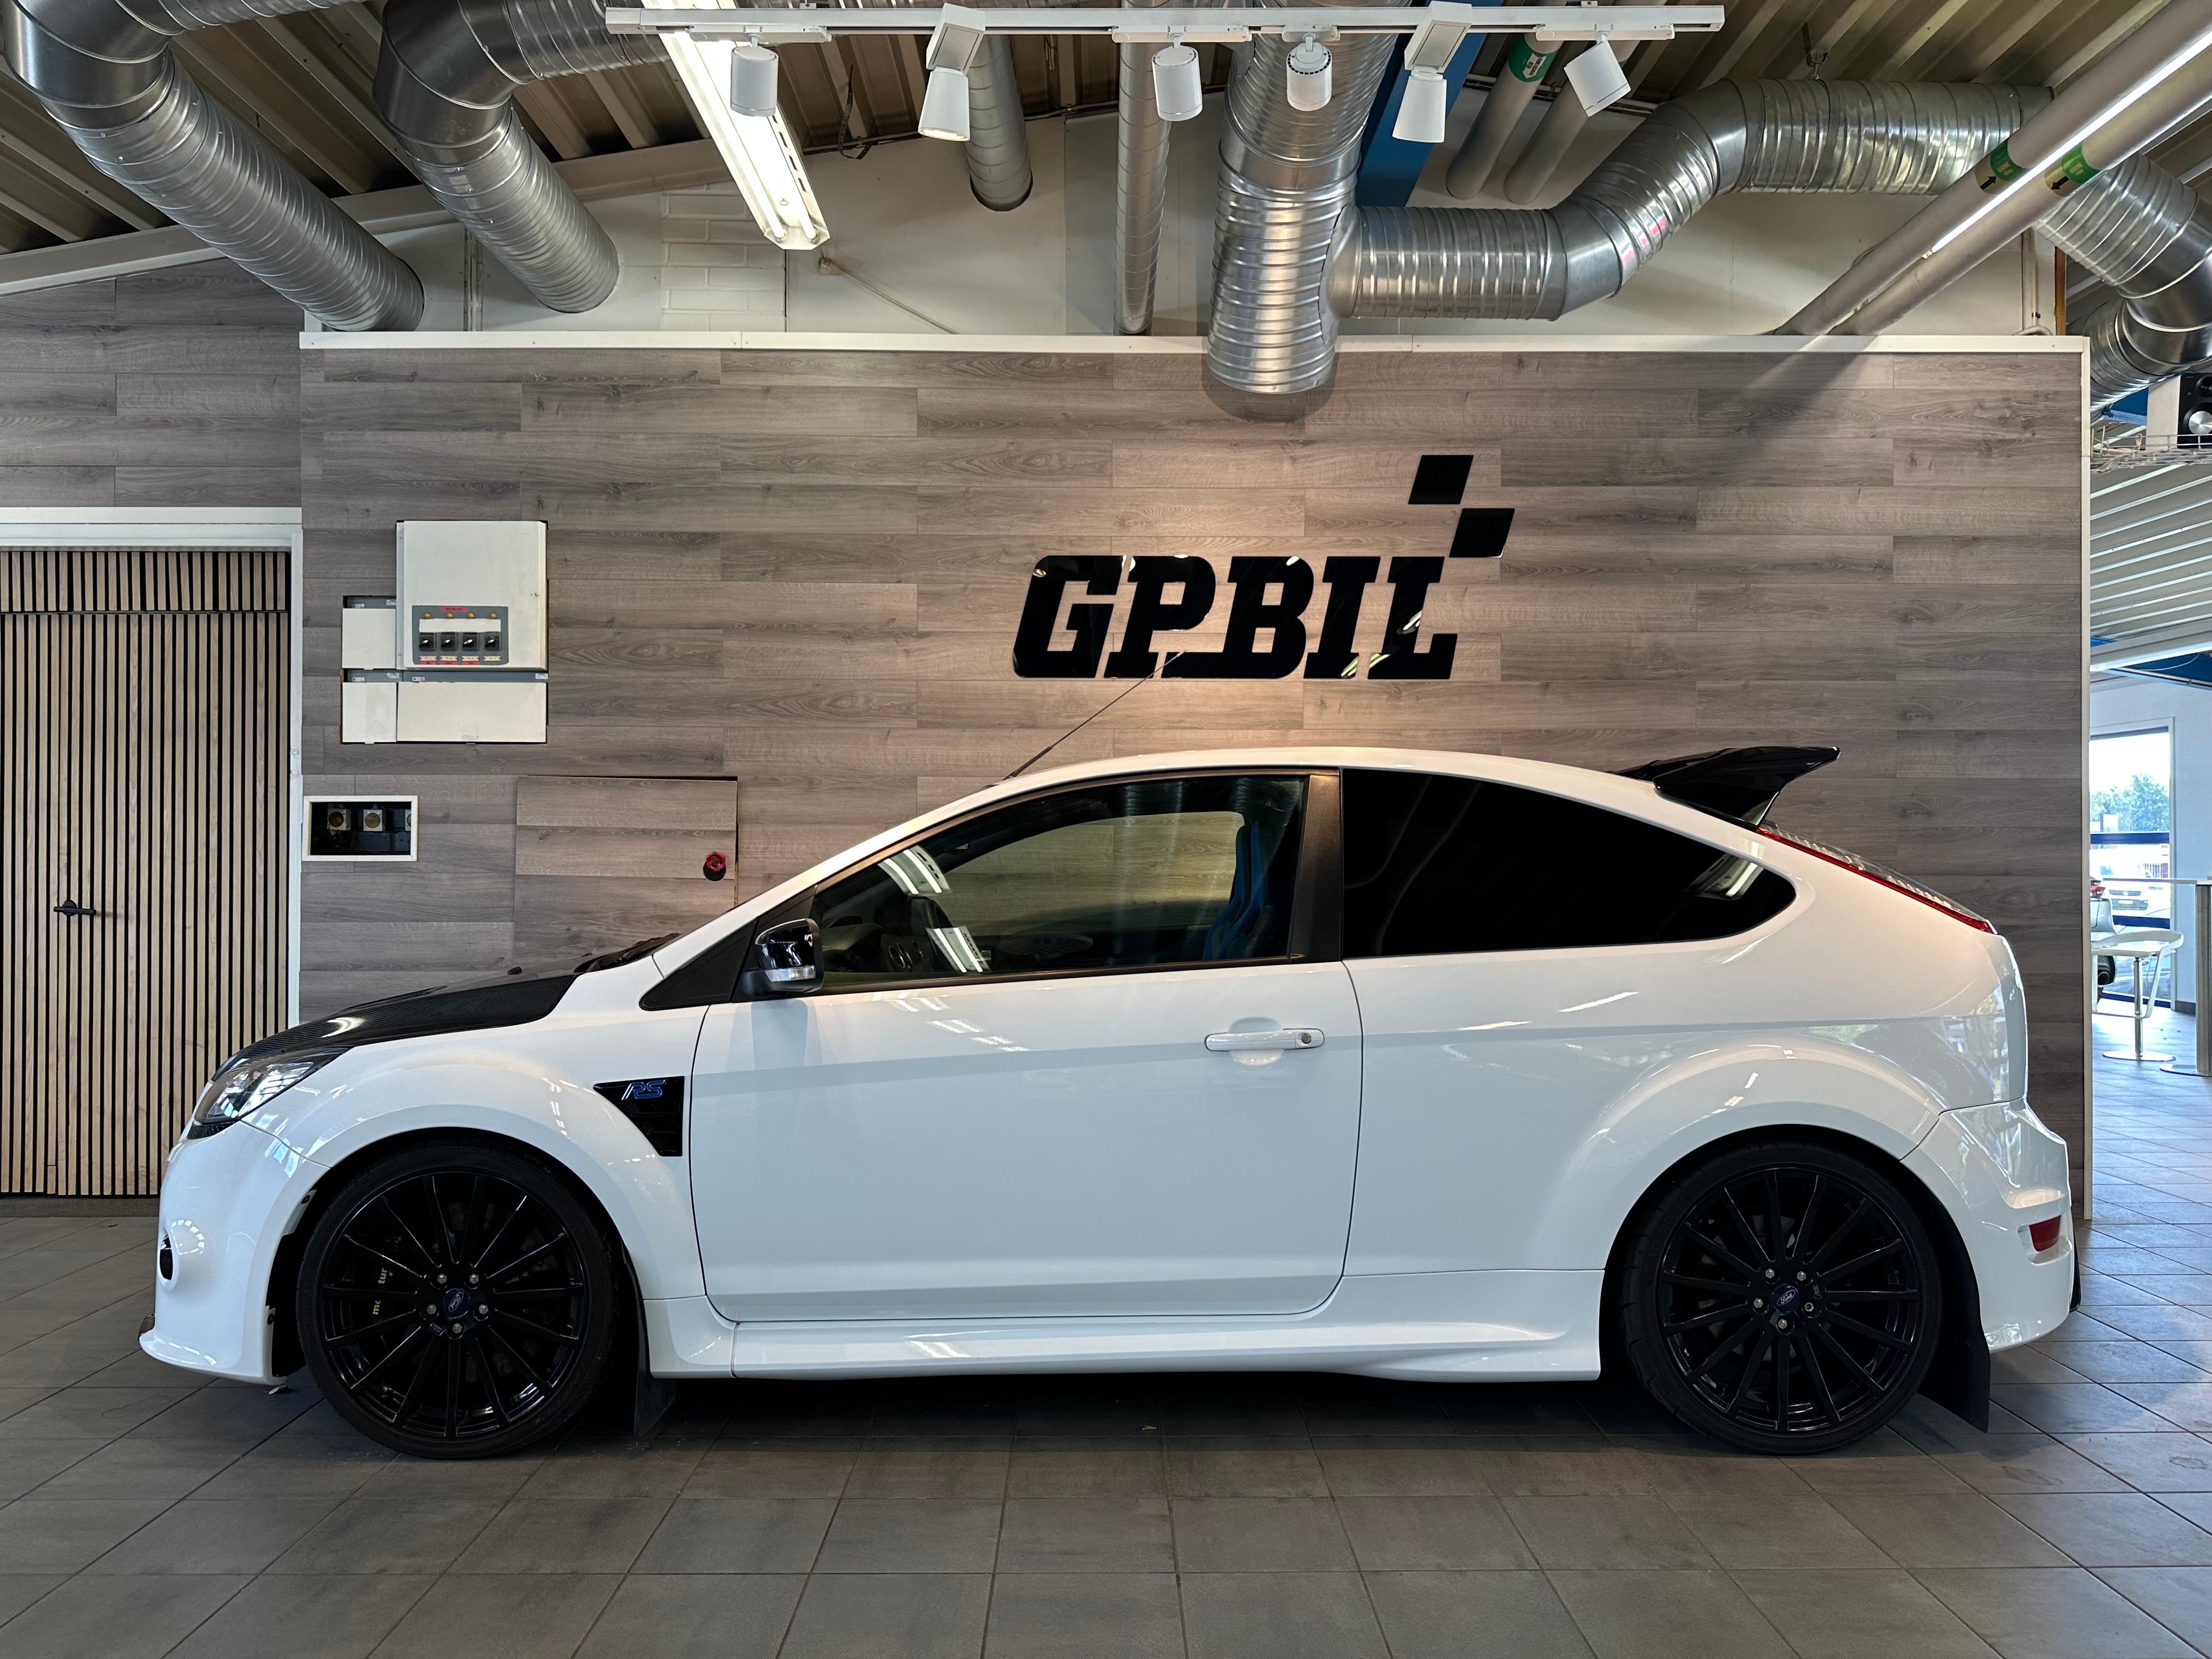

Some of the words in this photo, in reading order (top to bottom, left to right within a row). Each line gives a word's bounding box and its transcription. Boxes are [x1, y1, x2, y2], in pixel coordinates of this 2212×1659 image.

[1012, 555, 1458, 680] GPBIL
[622, 1079, 667, 1101] RS
[1779, 1291, 1793, 1305] Ford
